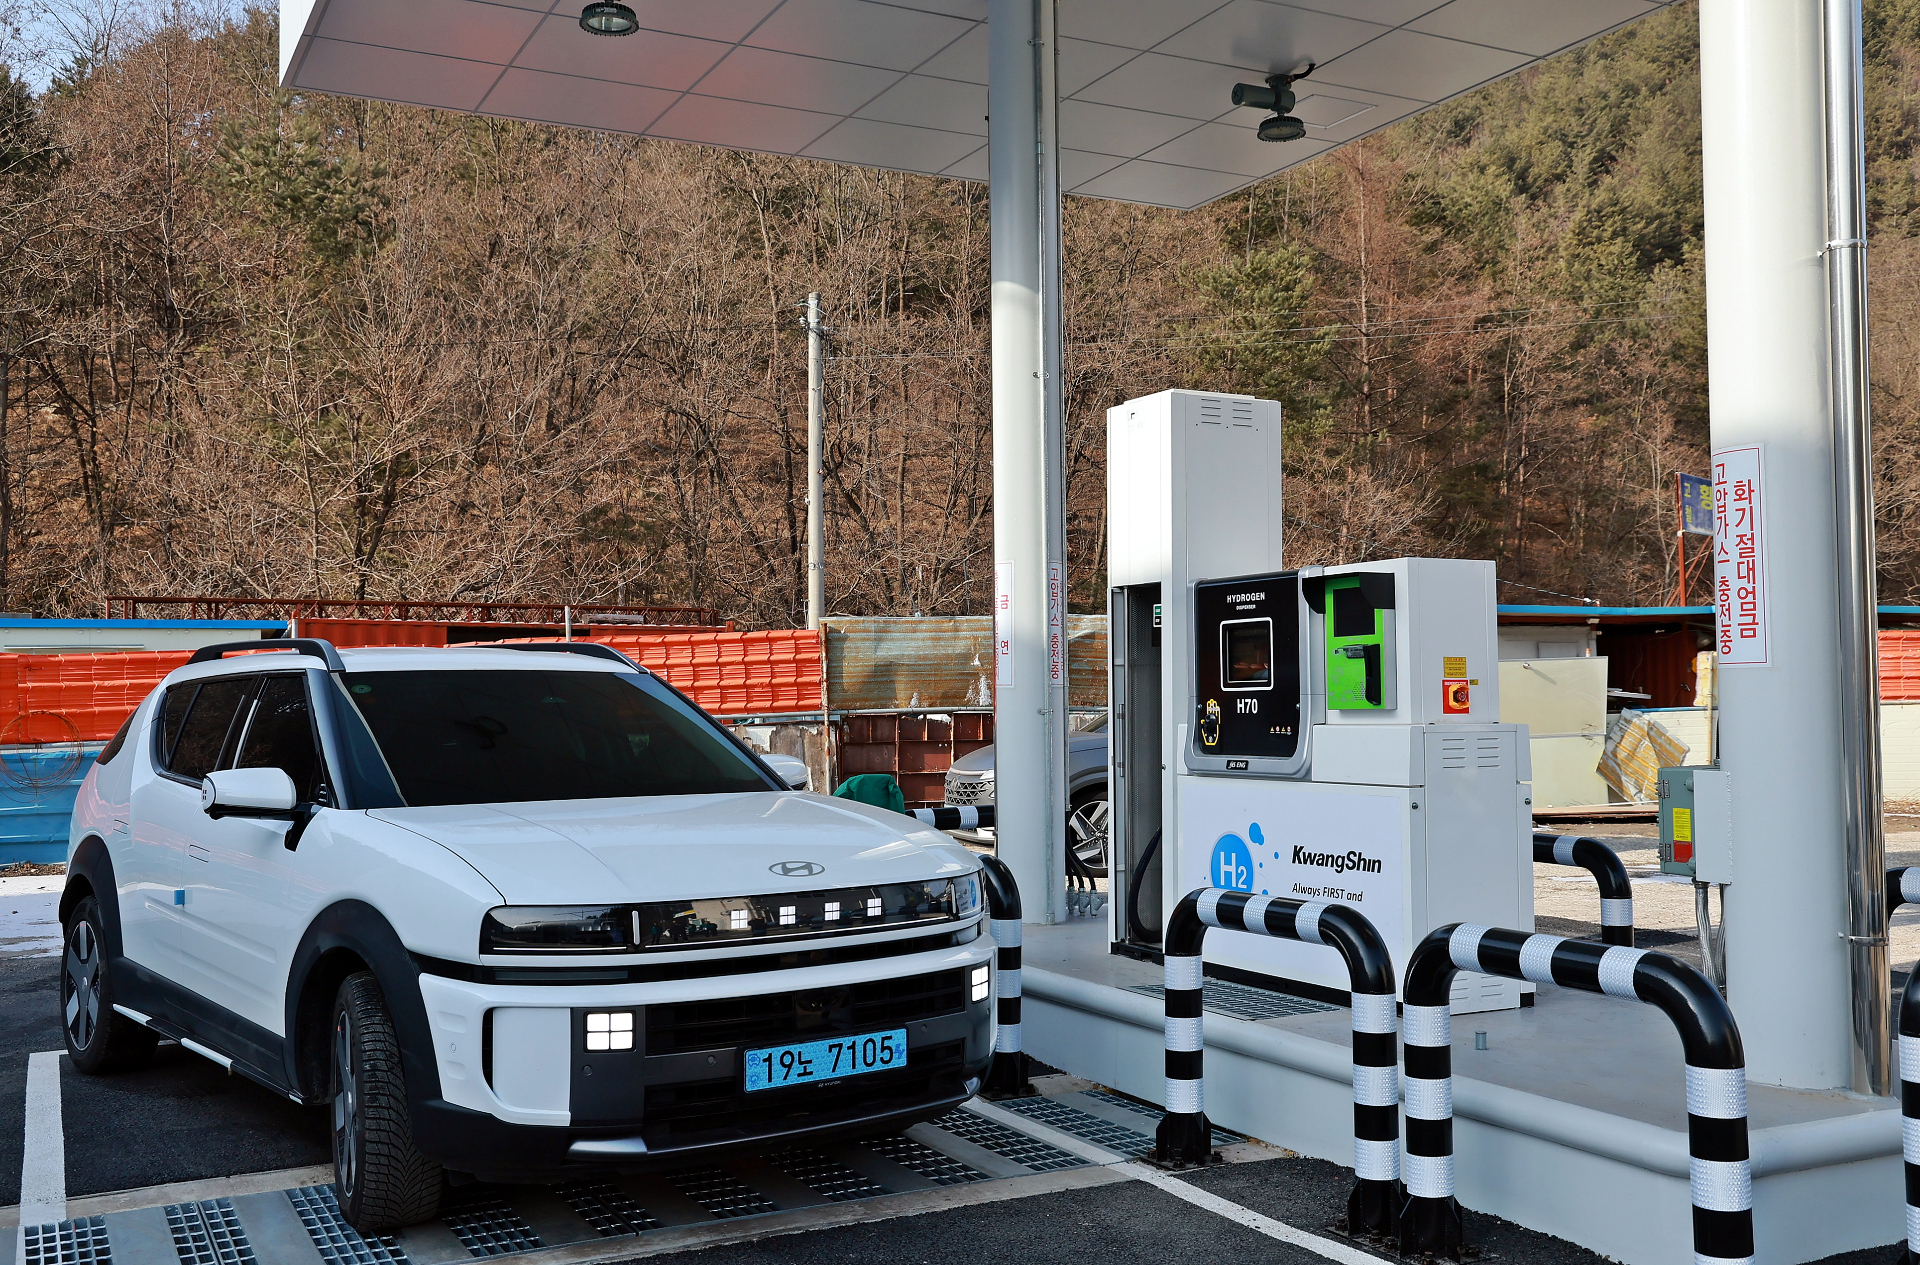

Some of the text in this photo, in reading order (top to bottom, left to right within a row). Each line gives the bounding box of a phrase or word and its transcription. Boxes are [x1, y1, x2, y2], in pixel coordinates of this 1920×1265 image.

[1714, 462, 1733, 655] 고압가스 충전중
[1733, 479, 1760, 639] 화기절대엄금
[1226, 591, 1266, 604] HYDROGEN
[1050, 567, 1060, 680] 고압가스 충전중
[1236, 698, 1258, 714] H70
[1291, 844, 1382, 874] KwangShin
[1291, 882, 1364, 902] Always FIRST and
[762, 1035, 894, 1083] 19노 7105
